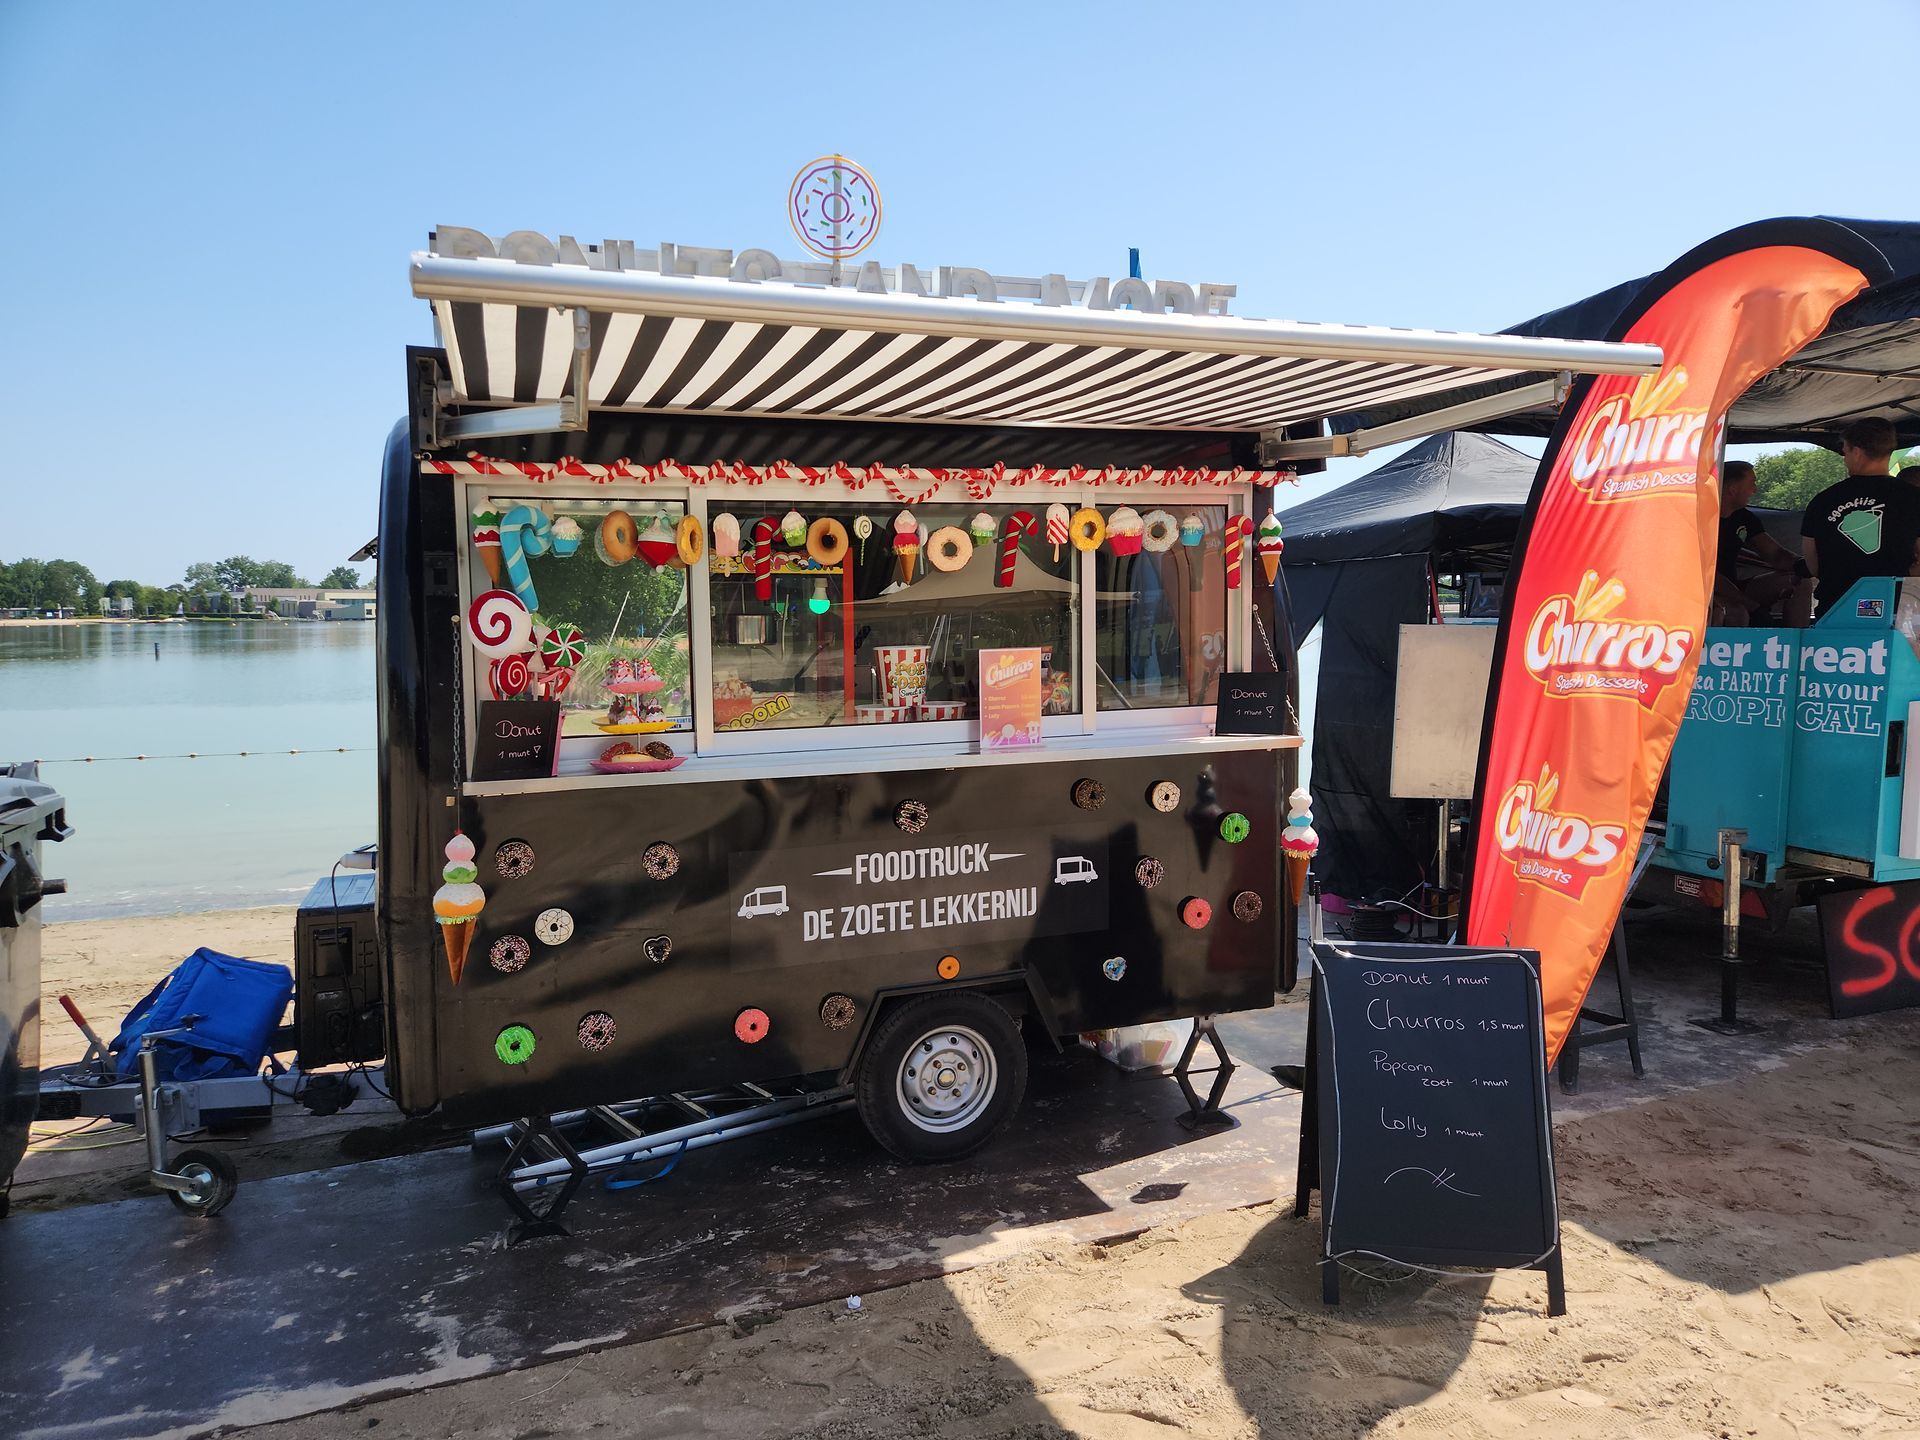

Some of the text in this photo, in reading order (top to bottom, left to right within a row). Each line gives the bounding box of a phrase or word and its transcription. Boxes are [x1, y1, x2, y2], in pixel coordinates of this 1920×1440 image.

[1602, 474, 1649, 497] Spanish
[1527, 599, 1690, 672] Churros
[985, 659, 1033, 687] Churros
[1720, 671, 1774, 693] PARTY
[1231, 688, 1268, 699] Donut
[495, 719, 541, 738] Donut
[498, 751, 504, 759] 1
[508, 749, 531, 758] munt
[856, 843, 989, 884] FOODTRUCK
[803, 886, 1038, 941] DE ZOETE LEKKERNIJ
[1362, 971, 1490, 986] Donut 1 munt
[1366, 998, 1465, 1030] Churros
[1478, 1020, 1498, 1032] 1,5
[1369, 1050, 1434, 1076] Popcorn
[1472, 1078, 1479, 1086] 1
[1483, 1078, 1509, 1087] munt
[1381, 1107, 1484, 1138] Lolly 1 munt
